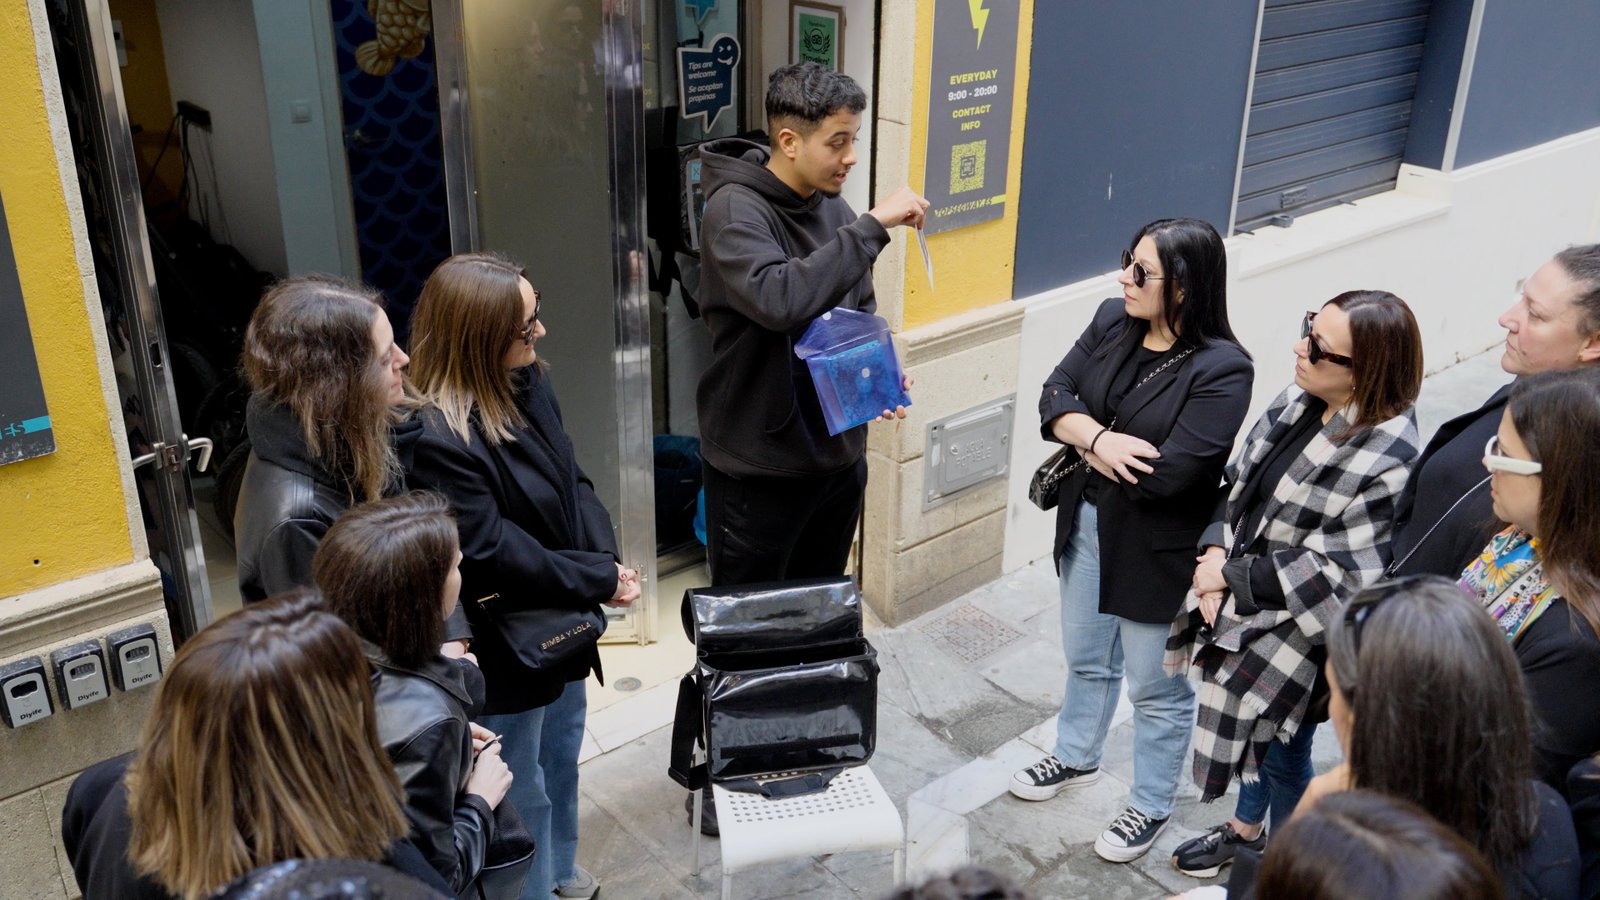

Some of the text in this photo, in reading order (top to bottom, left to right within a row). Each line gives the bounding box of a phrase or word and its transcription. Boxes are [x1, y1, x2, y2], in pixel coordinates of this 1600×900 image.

[688, 62, 702, 71] Tips
[688, 70, 717, 79] welcome
[950, 69, 998, 85] EVERYDAY
[688, 82, 724, 94] Se aceptan
[948, 90, 967, 102] 9:00
[974, 85, 998, 97] 20:00
[688, 94, 716, 104] propinas
[952, 104, 991, 119] CONTACT
[961, 120, 981, 131] INFO
[542, 621, 592, 650] BIMBA Y LOLA
[132, 672, 153, 684] Diyife
[77, 690, 100, 702] Diyife
[20, 707, 43, 721] Diyife
